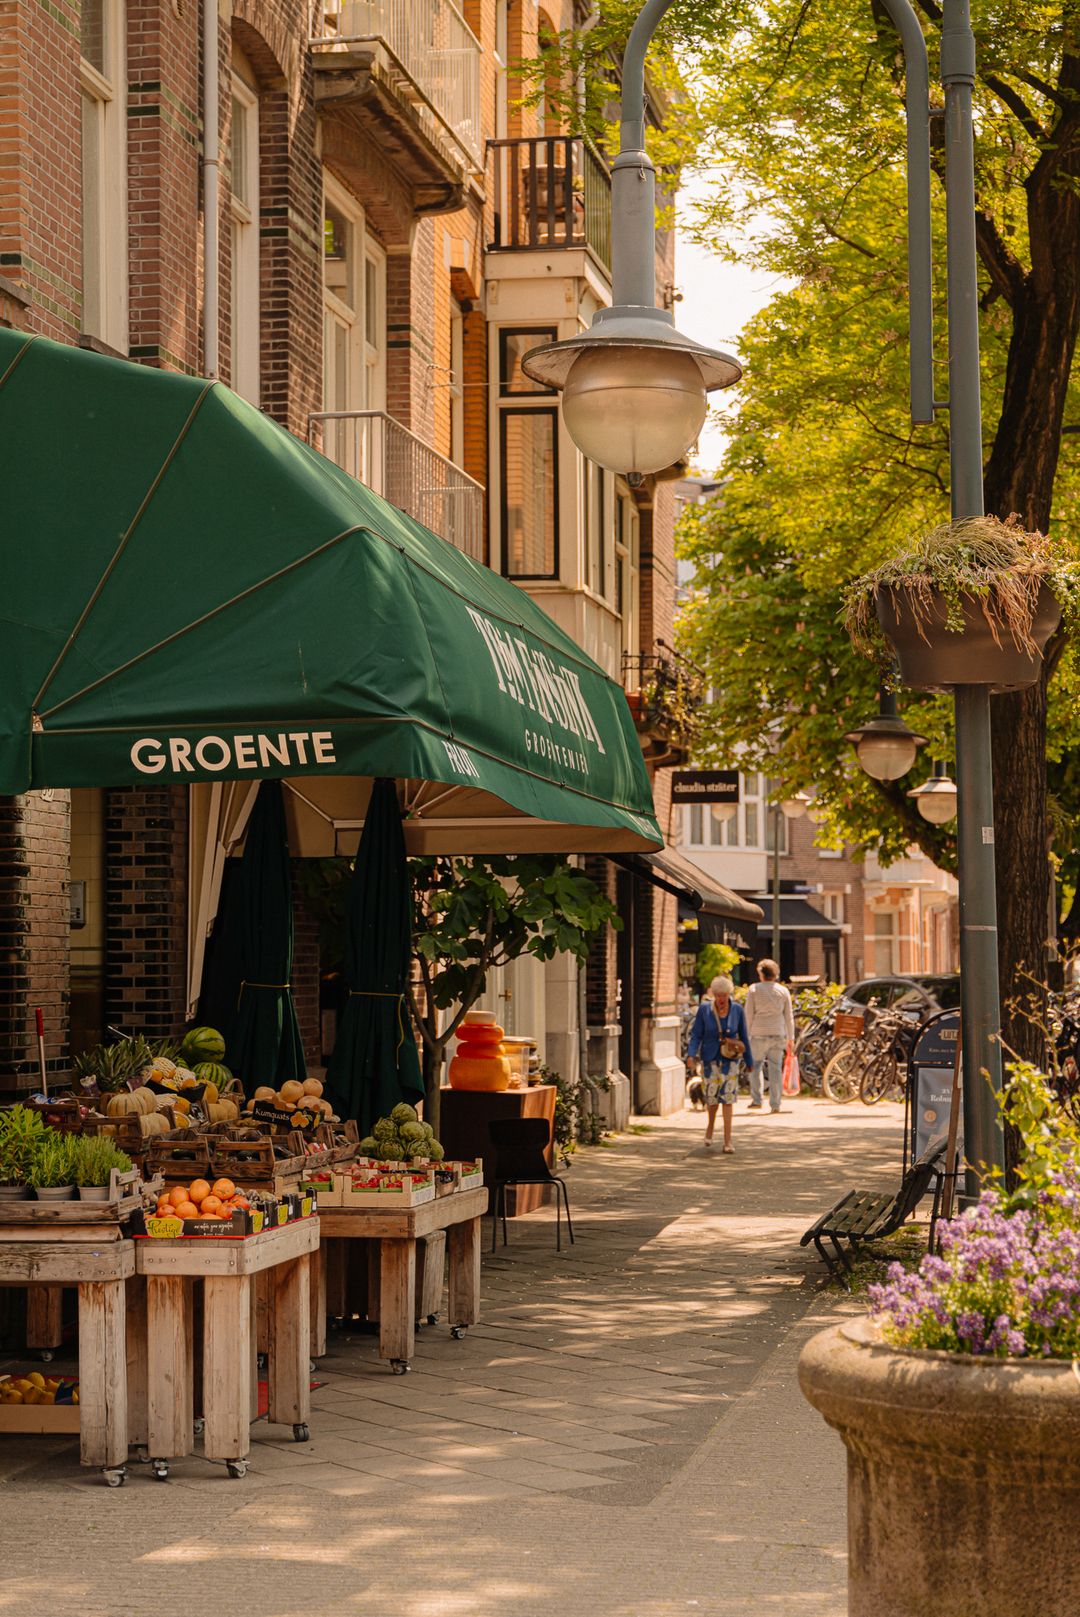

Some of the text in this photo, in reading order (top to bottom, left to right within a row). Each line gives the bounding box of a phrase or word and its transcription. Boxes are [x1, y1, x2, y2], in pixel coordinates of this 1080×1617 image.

[464, 605, 606, 755] TOM ENSINK
[130, 731, 337, 774] GROENTE
[440, 740, 481, 778] FRUIT
[255, 1107, 290, 1122] Kumquats
